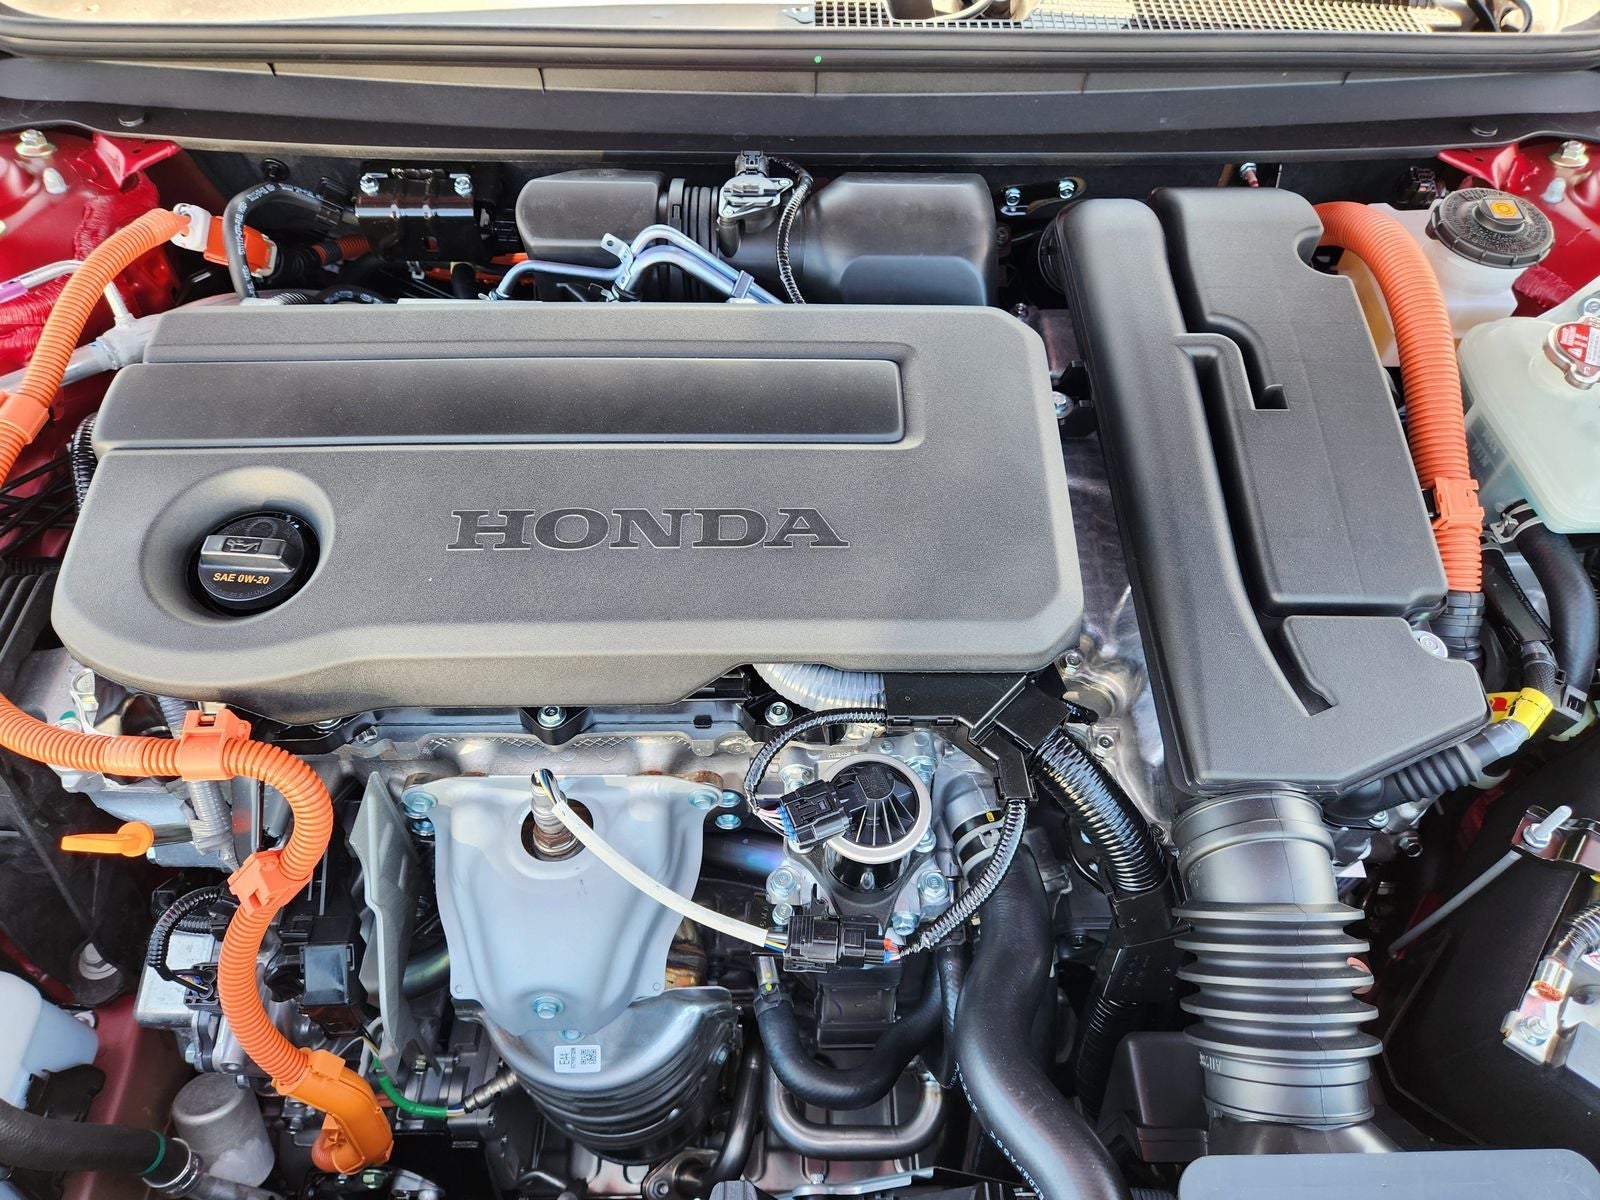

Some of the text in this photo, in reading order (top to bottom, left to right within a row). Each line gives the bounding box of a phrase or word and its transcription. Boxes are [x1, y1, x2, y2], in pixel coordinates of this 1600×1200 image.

[446, 507, 850, 550] HONDA
[213, 572, 270, 585] SAE 0W-20
